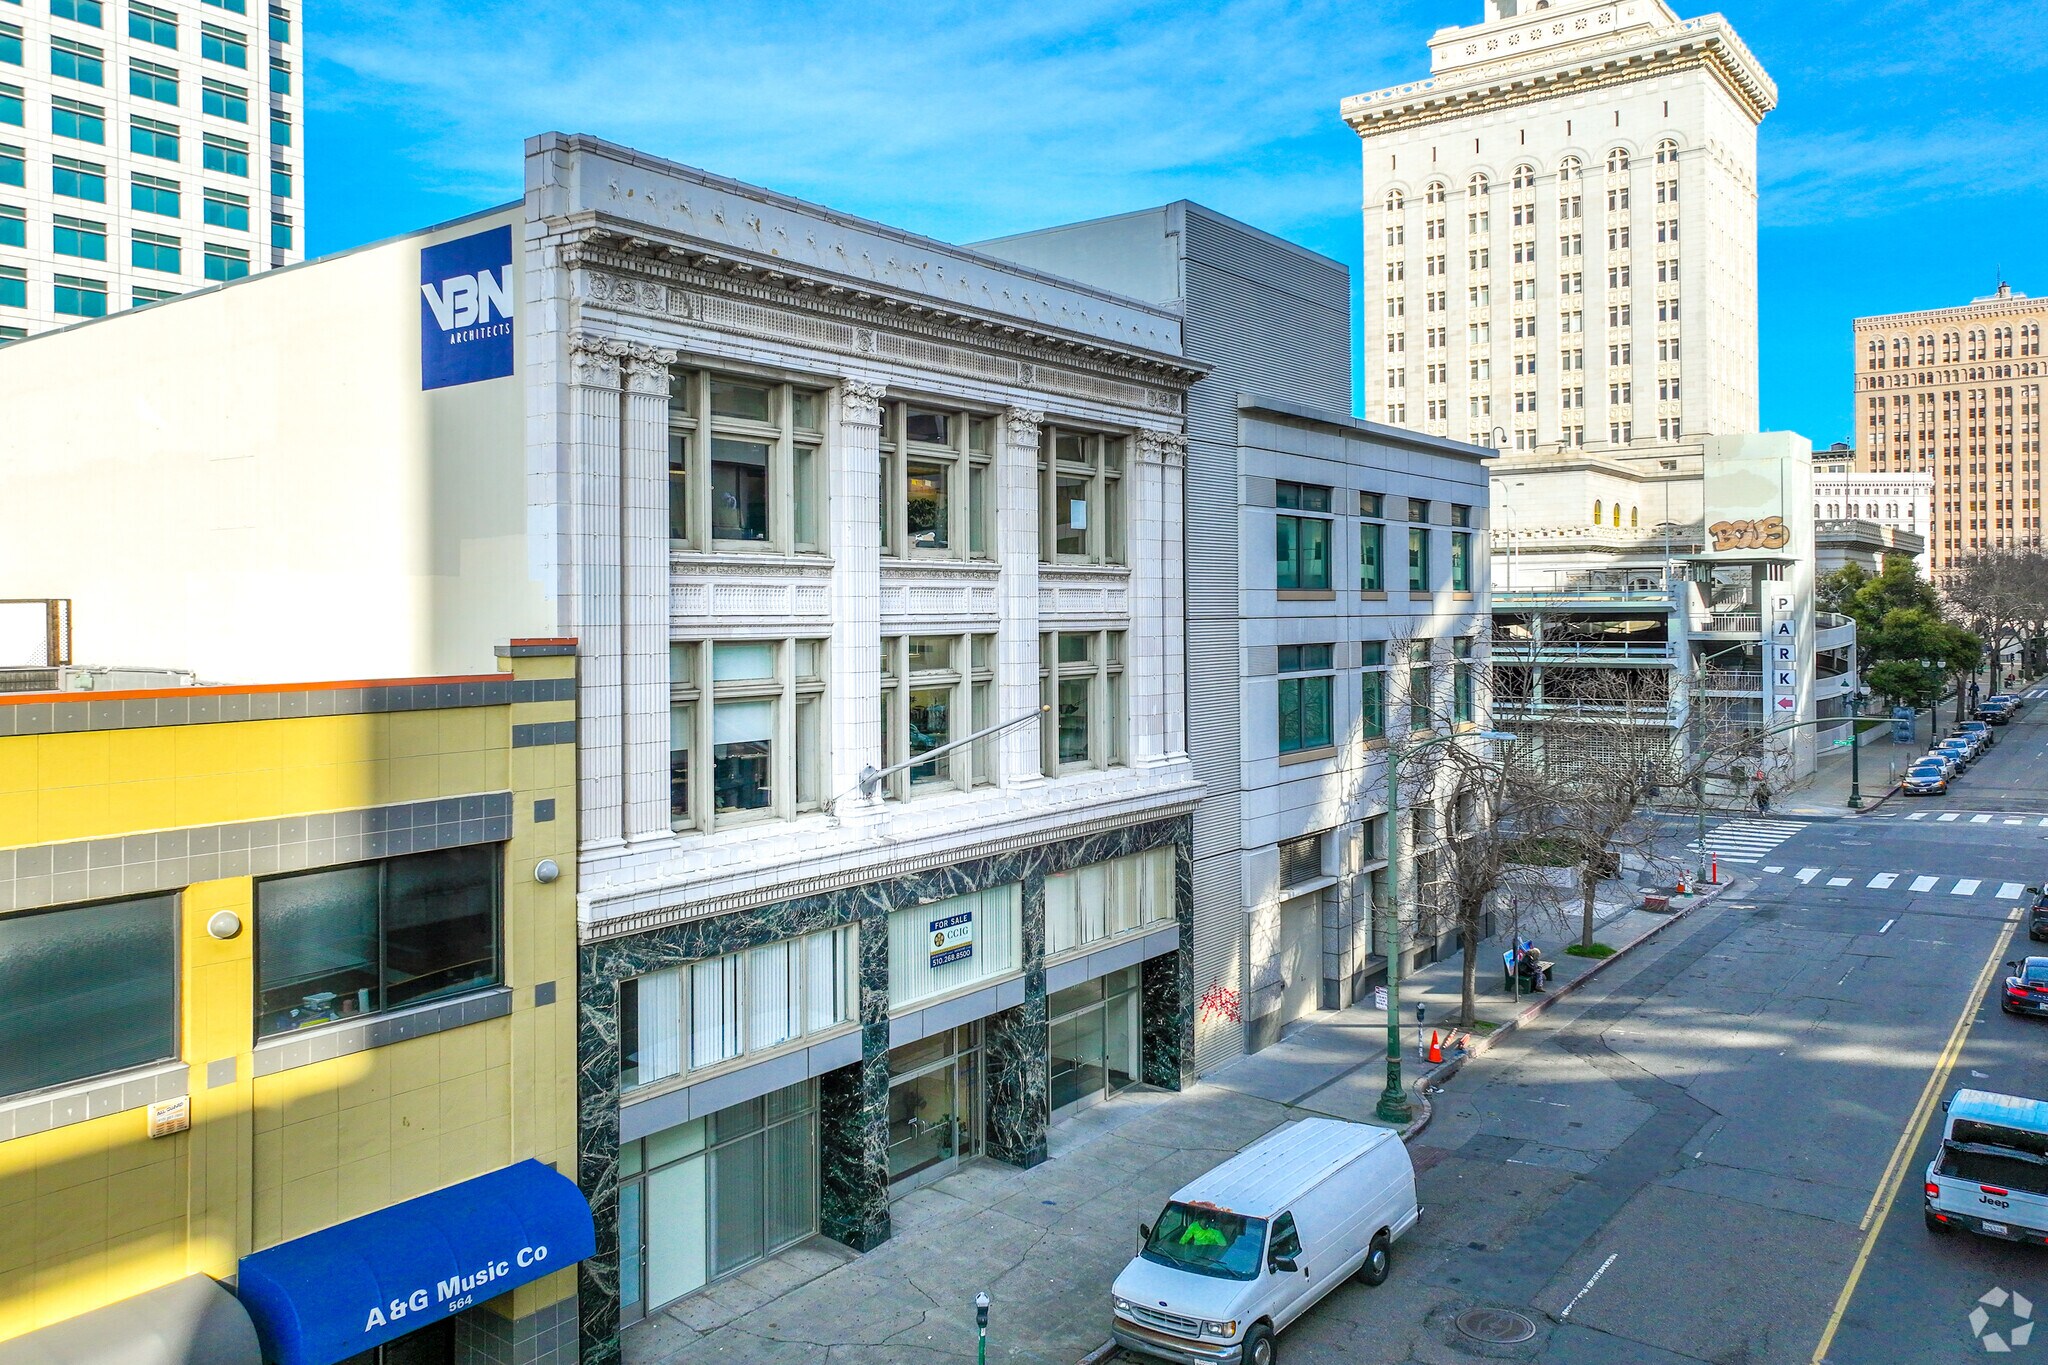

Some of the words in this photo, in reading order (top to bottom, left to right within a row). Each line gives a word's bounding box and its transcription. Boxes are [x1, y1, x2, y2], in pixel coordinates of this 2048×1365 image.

[420, 264, 513, 331] VBN
[450, 323, 511, 345] ARCHITECTS
[1778, 598, 1790, 684] PARK
[934, 919, 949, 930] FOR
[950, 914, 968, 925] SALE
[947, 926, 969, 939] CCIG
[932, 949, 971, 966] 510.268.8500
[1979, 1195, 2010, 1209] Jeep
[436, 1260, 510, 1303] Music
[516, 1244, 548, 1269] Co
[448, 1293, 473, 1313] 564
